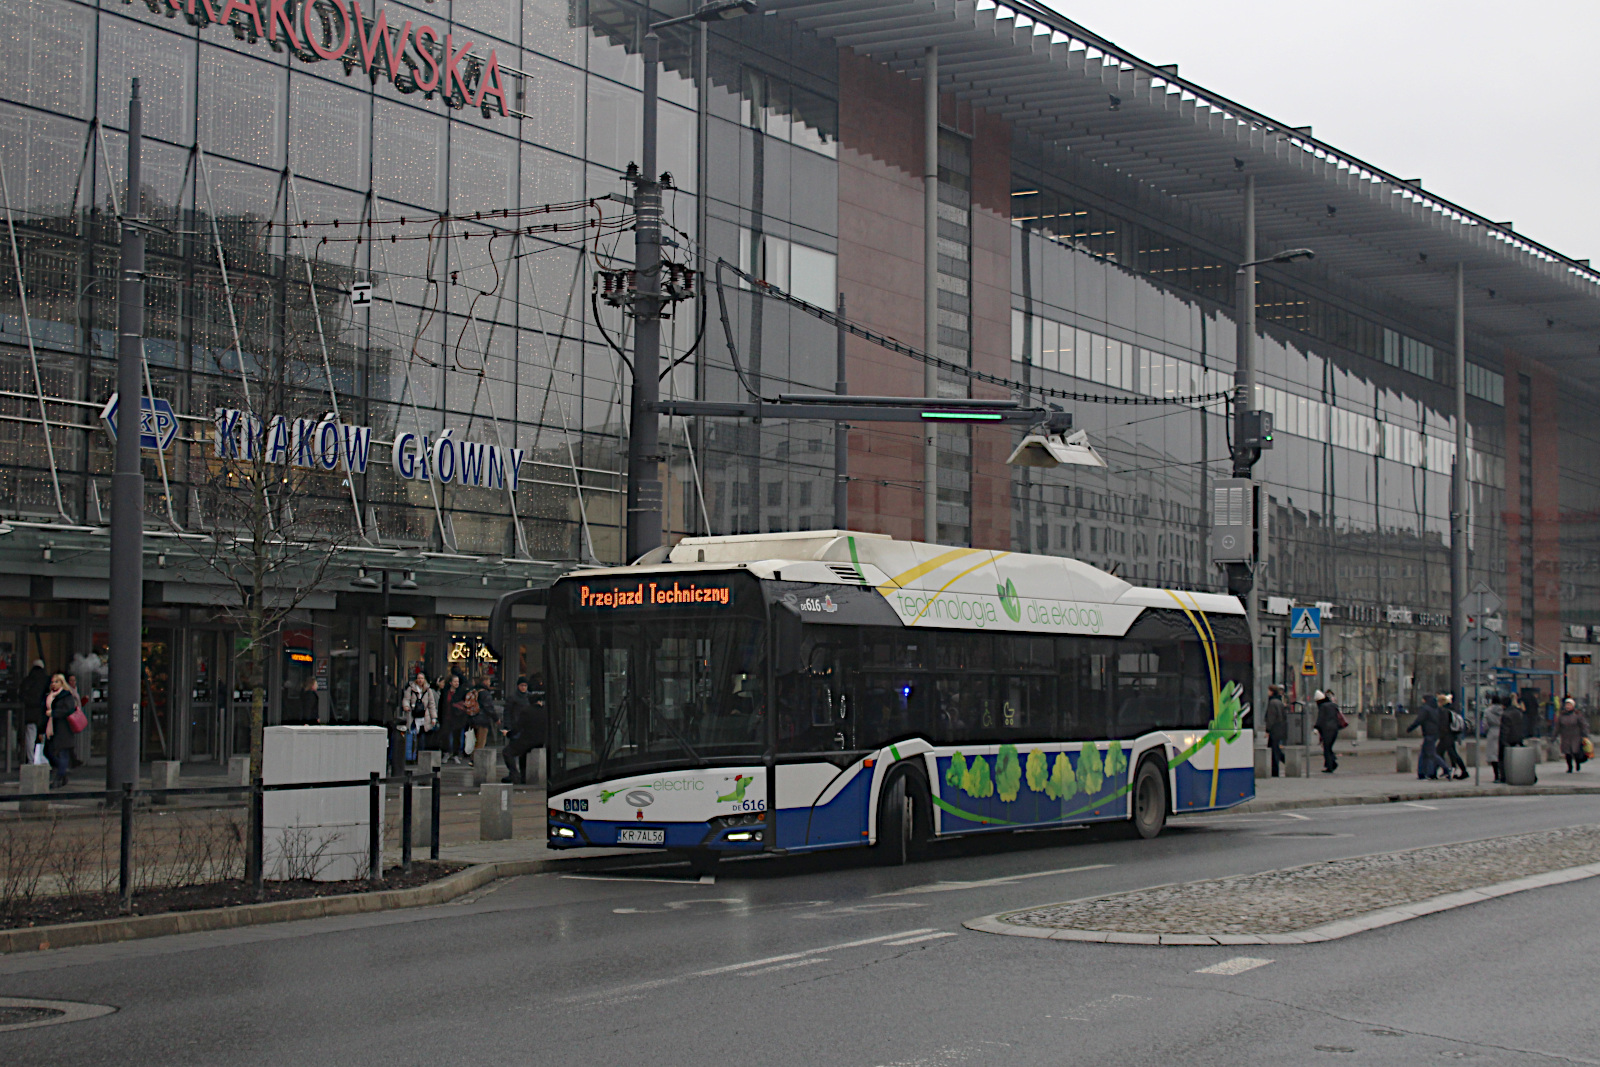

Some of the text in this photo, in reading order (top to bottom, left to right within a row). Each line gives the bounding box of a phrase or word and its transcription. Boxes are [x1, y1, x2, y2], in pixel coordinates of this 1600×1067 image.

[140, 412, 170, 434] KP
[215, 407, 524, 491] KRAKÓW GŁÓWNY
[581, 581, 729, 608] Przejazd Techniczny
[897, 591, 1104, 633] technologia dla ekologii
[653, 777, 704, 792] electric
[622, 830, 663, 842] KR 7AL56
